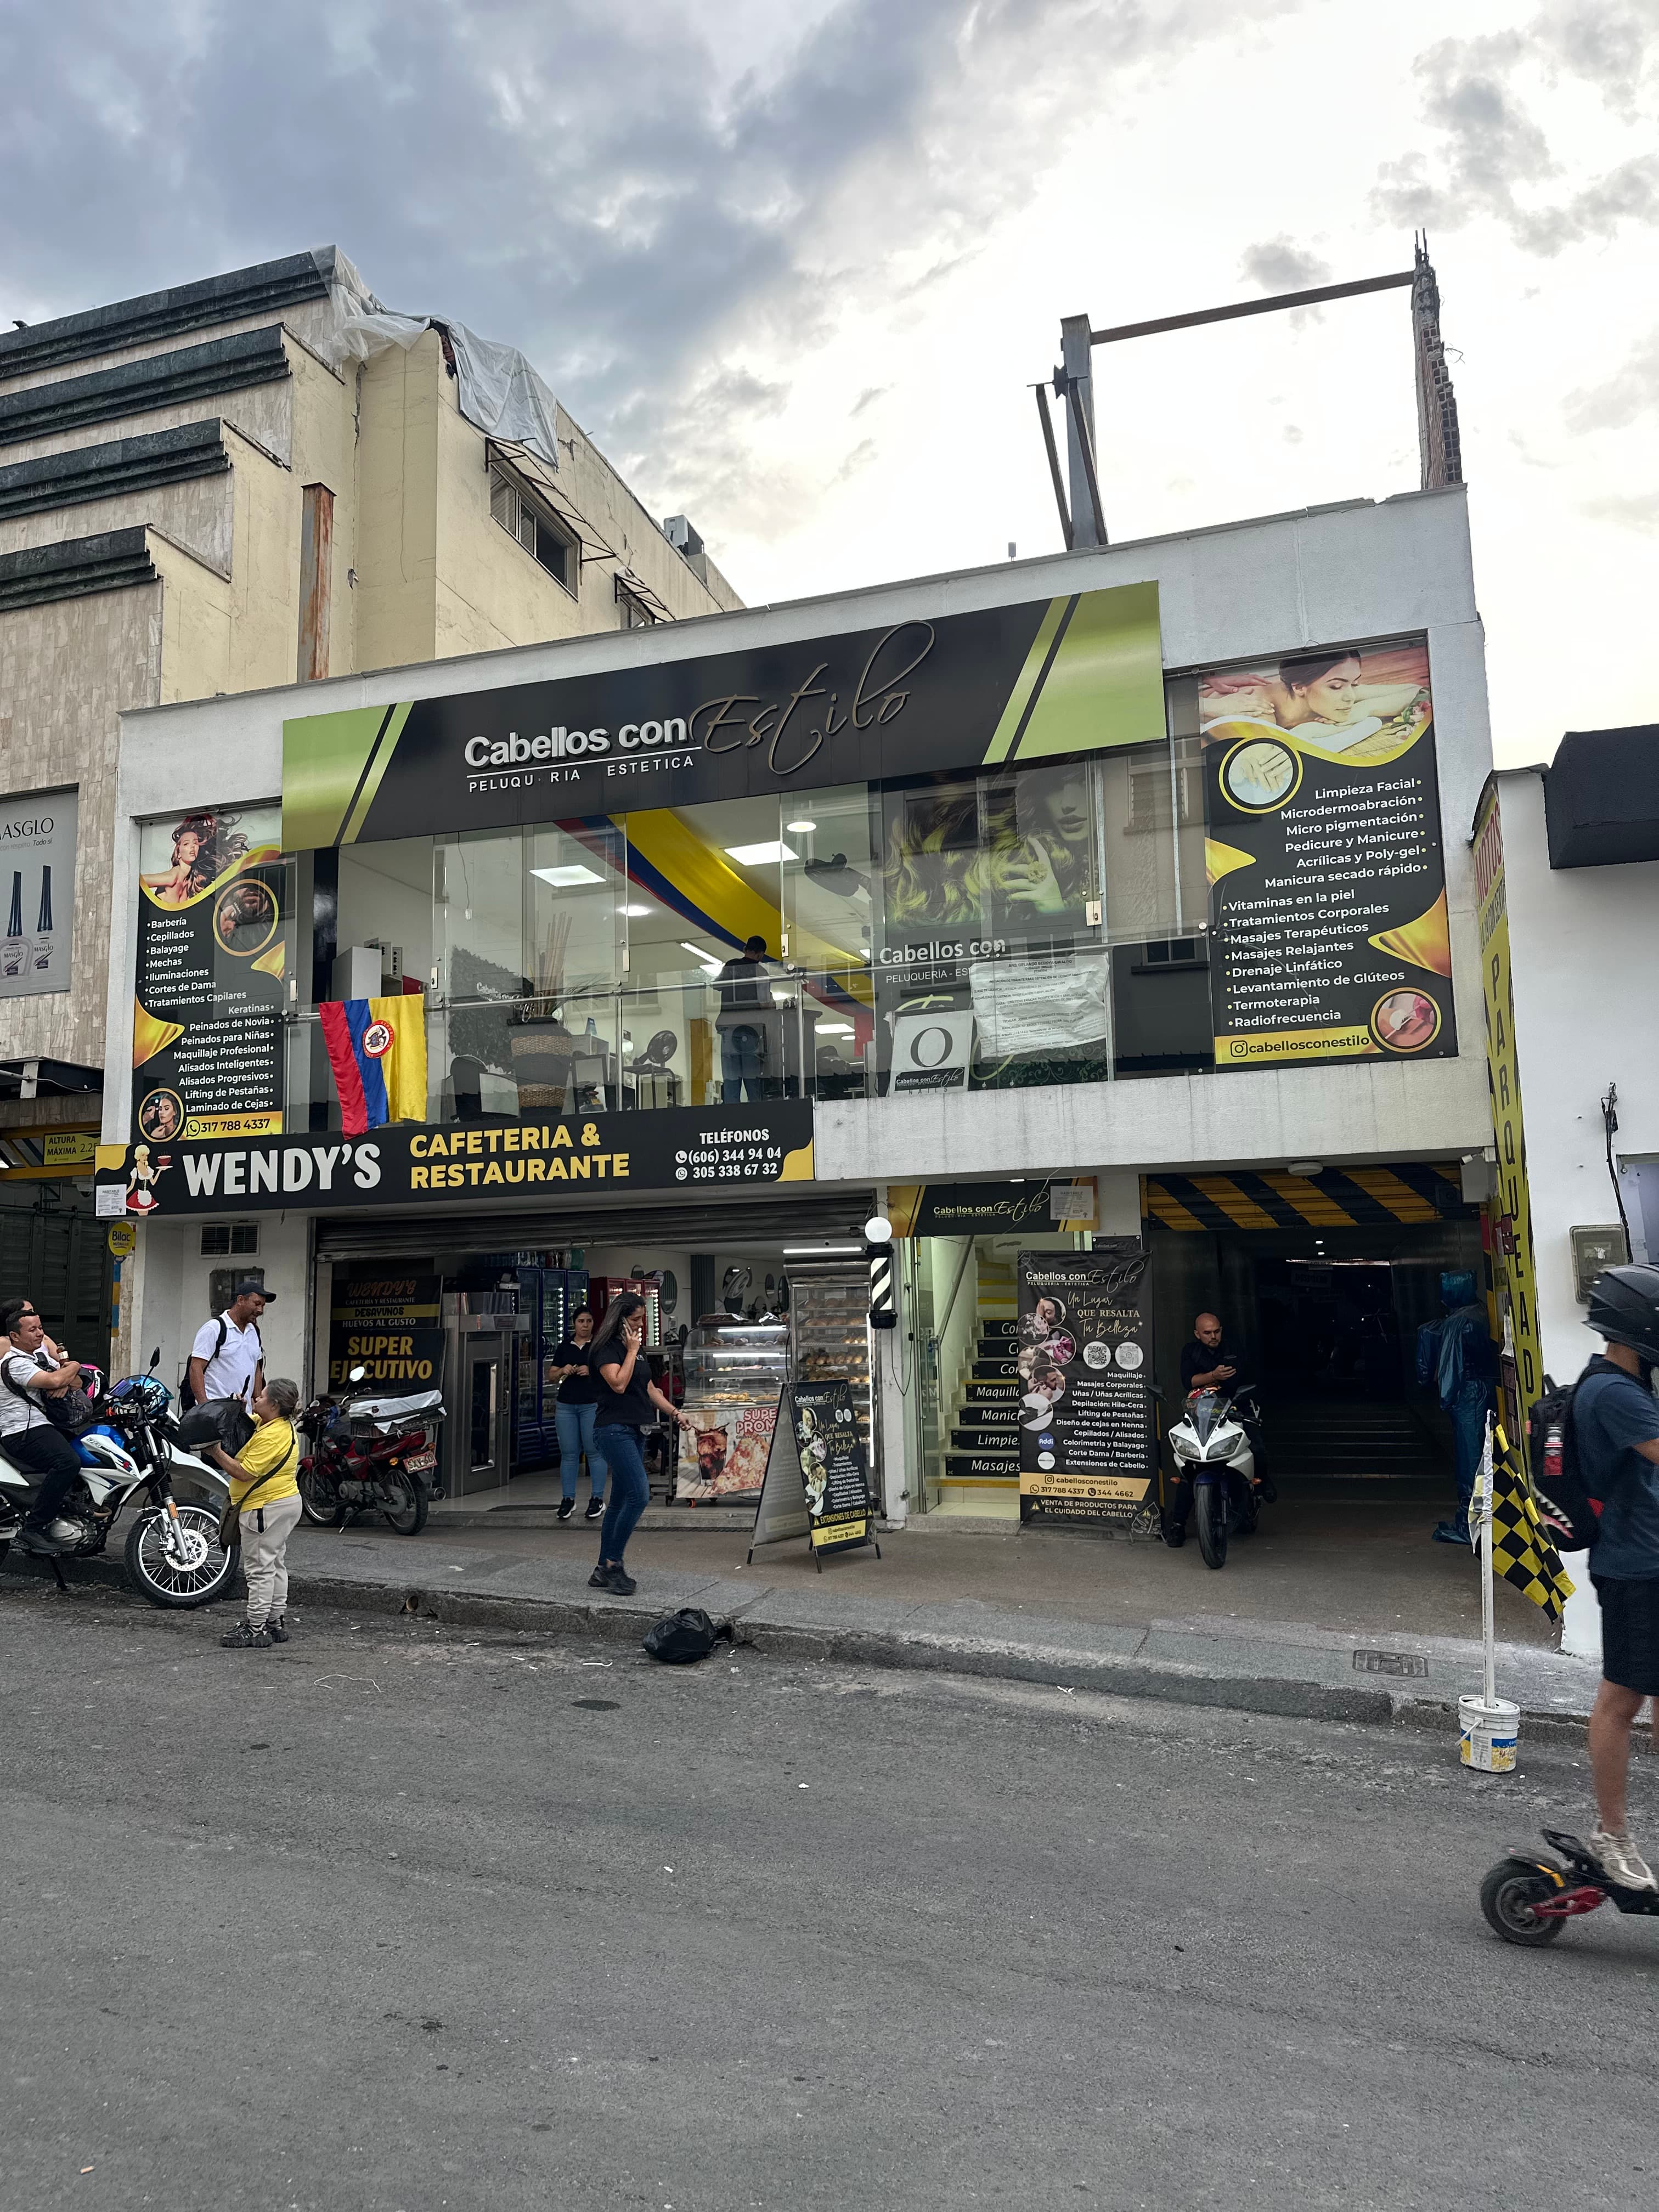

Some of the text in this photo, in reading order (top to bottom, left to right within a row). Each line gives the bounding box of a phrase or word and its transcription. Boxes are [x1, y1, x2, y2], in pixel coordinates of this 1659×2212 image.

[465, 620, 935, 776] Cabellos con Estilo
[607, 756, 695, 777] ESTETICA
[1315, 778, 1415, 799] Limpieza Facial
[1280, 795, 1416, 820] Microdermoabración
[0, 817, 54, 840] ASGLO
[1286, 812, 1417, 836] Micro pigmentación
[1285, 830, 1419, 853] Pedicure y Manicure
[1296, 845, 1420, 868] Acrílicas y Poly-gel
[1475, 800, 1502, 911] MOTOS
[1265, 862, 1421, 888] Manicura secado rápido
[1228, 889, 1355, 912] Vitaminas en la piel
[151, 917, 187, 929] Barbería
[1229, 903, 1390, 928] Tratamientos Corporales
[151, 930, 194, 943] Cepillados
[1231, 922, 1369, 945] Masajes Terapéuticos
[150, 944, 189, 956] Balayage
[879, 938, 1006, 964] Cabellos con
[1231, 940, 1354, 962] Masajes Relajantes
[150, 958, 182, 968] Mechas
[1232, 958, 1343, 978] Drenaje Linfático
[149, 968, 209, 981] Iluminaciones
[886, 970, 947, 984] PELUQUERÍA
[1233, 970, 1405, 994] Levantamiento de Glúteos
[149, 982, 217, 995] Cortes de Dama
[149, 991, 247, 1008] Tratamientos Capilares
[1233, 995, 1320, 1011] Termoterapia
[228, 1004, 270, 1014] Keratinas
[190, 1017, 270, 1032] Peinados de Novia
[1234, 1010, 1341, 1028] Radiofrecuencia
[182, 1030, 270, 1046] Peinados para Niñas
[1249, 1035, 1370, 1053] cabellosconestilo
[173, 1044, 270, 1060] Maquillaje Profesional
[910, 1027, 953, 1068] O
[178, 1058, 269, 1073] Alisados Inteligentes
[179, 1072, 269, 1086] Alisados Progresivos
[185, 1085, 269, 1100] Lifting de Pestañas
[186, 1099, 269, 1113] Laminado de Cejas
[201, 1118, 270, 1132] 317 788 4337
[48, 1136, 76, 1144] ALTURA
[410, 1122, 601, 1158] CAFETERIA &
[699, 1127, 769, 1145] TELÉFONOS
[47, 1147, 77, 1156] MÁXIMA
[688, 1146, 781, 1166] (606) 344 94 04
[182, 1143, 381, 1197] WENDY'S
[411, 1153, 630, 1189] RESTAURANTE
[692, 1162, 778, 1180] 305 338 67 32
[933, 1192, 1049, 1222] Cabellos con Estilo
[1026, 1260, 1144, 1293] Cabellos con Estilo
[1082, 1291, 1113, 1309] Lugar
[355, 1307, 404, 1317] DESAYUNOS
[1077, 1310, 1141, 1318] QUE RESALTA
[342, 1319, 374, 1328] HUEVOS
[388, 1318, 416, 1327] GUSTO
[1079, 1318, 1138, 1339] Tu Belleza
[347, 1336, 414, 1356] SUPER
[1074, 1430, 1110, 1438] Cepillados
[1113, 1441, 1145, 1449] Balayage
[971, 1460, 1020, 1474] Masajes
[1066, 1459, 1108, 1468] Extensiones
[1056, 1477, 1118, 1486] cabellosconestilo
